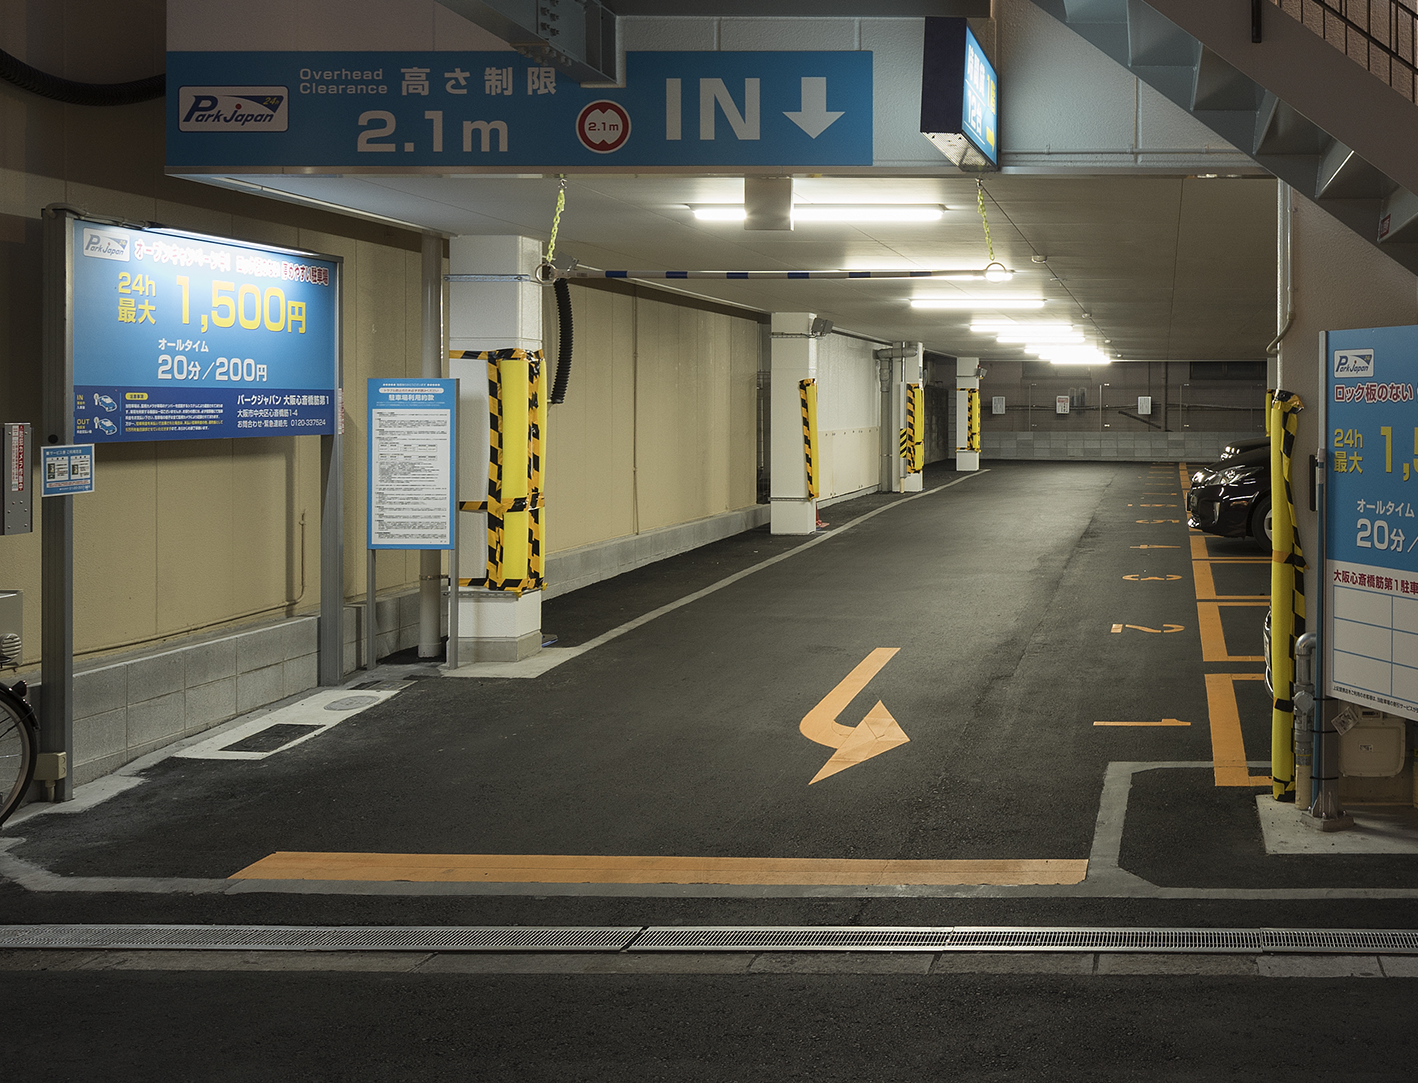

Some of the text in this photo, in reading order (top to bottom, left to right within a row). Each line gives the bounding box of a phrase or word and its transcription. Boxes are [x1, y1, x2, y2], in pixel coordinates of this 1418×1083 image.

[299, 68, 384, 81] Overhead
[401, 66, 558, 97] 高さ制限
[299, 82, 388, 95] Clearance
[183, 94, 225, 123] Park
[225, 103, 275, 127] Japan
[666, 77, 761, 140] IN
[588, 121, 620, 132] 2.1m
[118, 271, 156, 297] 24h
[118, 297, 156, 325] 最大
[176, 275, 306, 333] 1,500円
[158, 338, 209, 353] オールタイム
[158, 354, 268, 382] 20分/200円
[1336, 355, 1351, 373] Park
[1350, 360, 1370, 374] Japan
[237, 394, 282, 406] パークジャパン
[1334, 383, 1413, 402] ロック板のない
[1334, 428, 1363, 448] 24h
[1333, 451, 1364, 474] 最大
[1356, 498, 1415, 518] オールタイム
